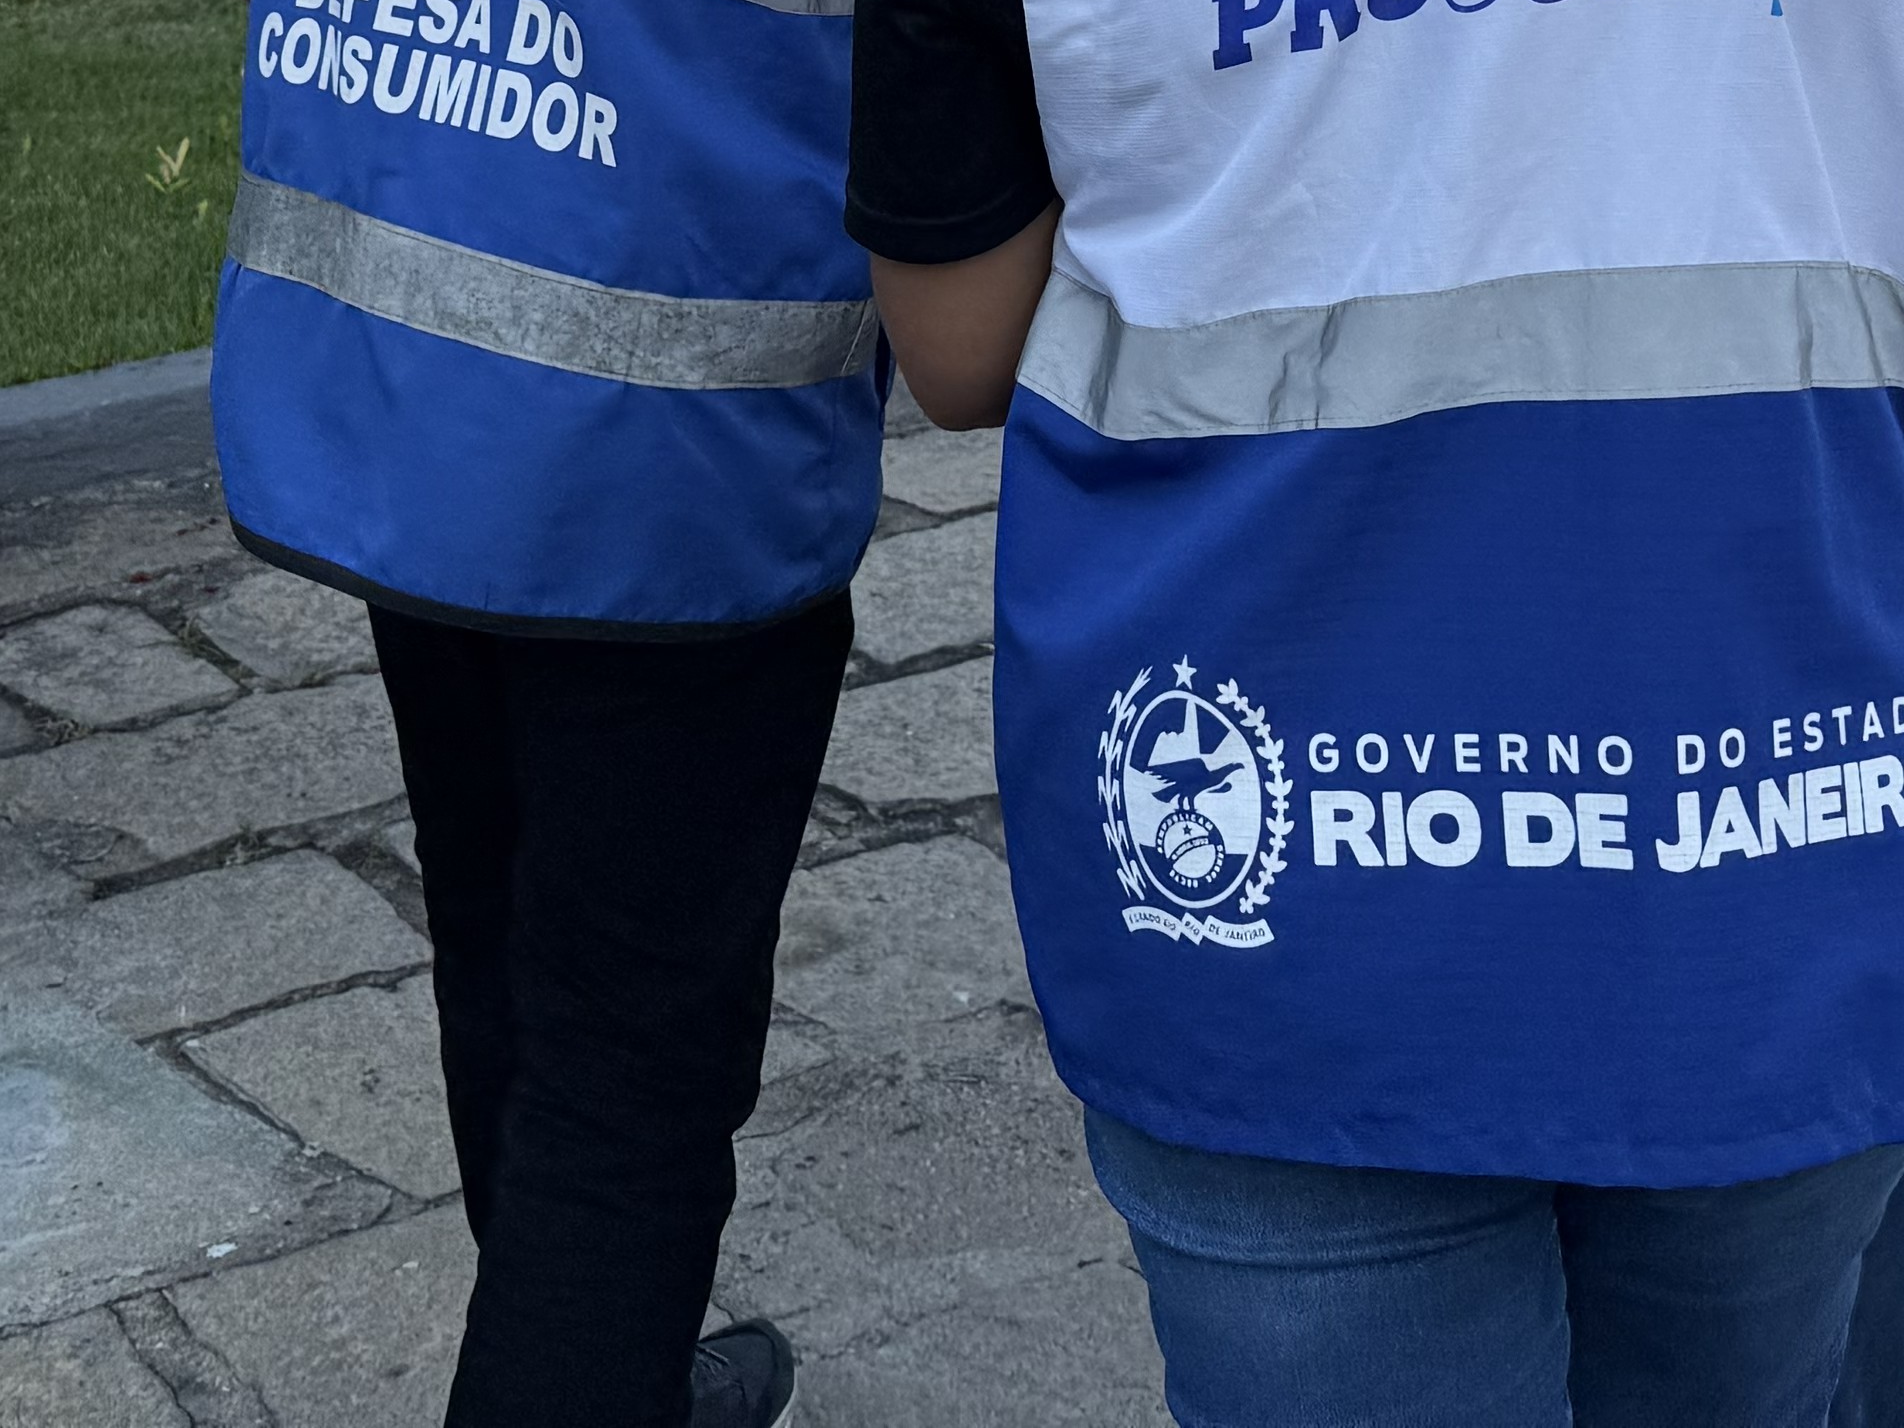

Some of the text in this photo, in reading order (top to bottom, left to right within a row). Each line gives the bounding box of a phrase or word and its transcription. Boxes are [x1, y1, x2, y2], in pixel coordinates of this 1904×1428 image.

[258, 11, 618, 168] CONSUMIDOR
[1308, 732, 1634, 776] GOVERNO
[1677, 728, 1747, 775] DO
[1310, 789, 1483, 868] RIO
[1501, 790, 1635, 871] DE
